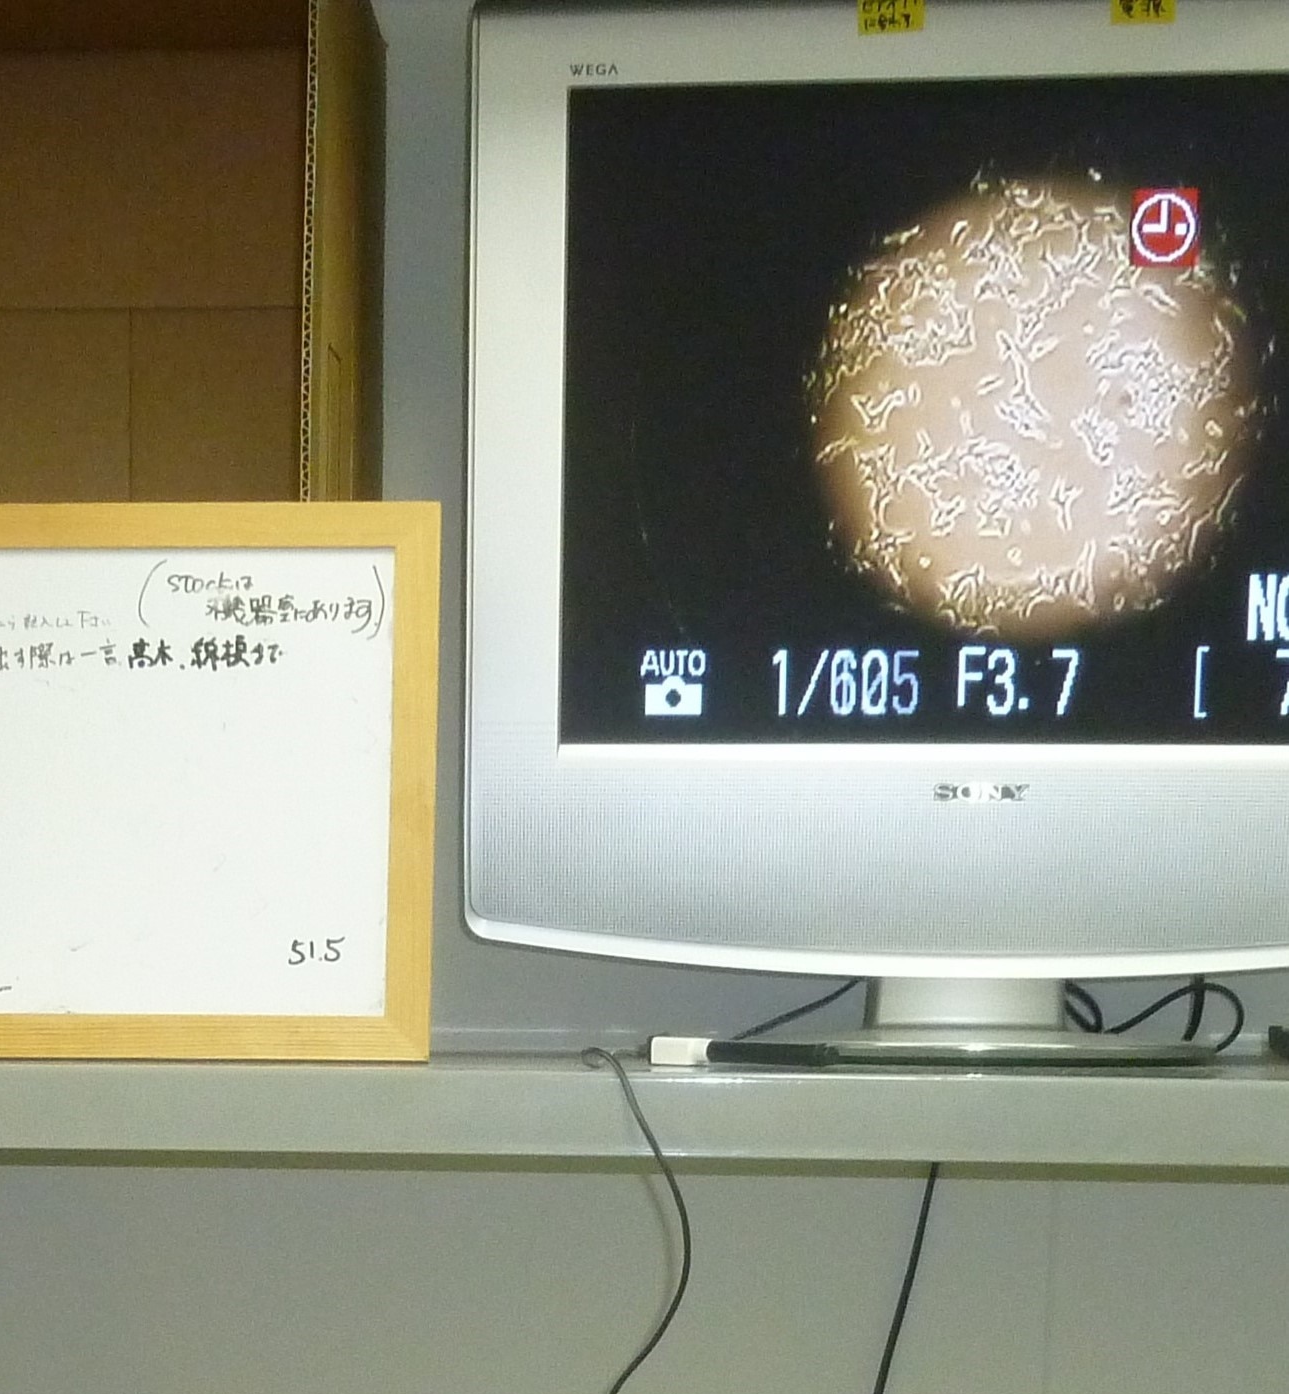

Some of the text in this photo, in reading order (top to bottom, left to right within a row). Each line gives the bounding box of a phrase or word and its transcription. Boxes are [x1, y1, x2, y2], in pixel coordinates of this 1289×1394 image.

[569, 63, 618, 76] WEGA
[640, 649, 706, 676] AUTO
[933, 782, 1030, 802] SONY
[288, 936, 346, 965] 51.5
